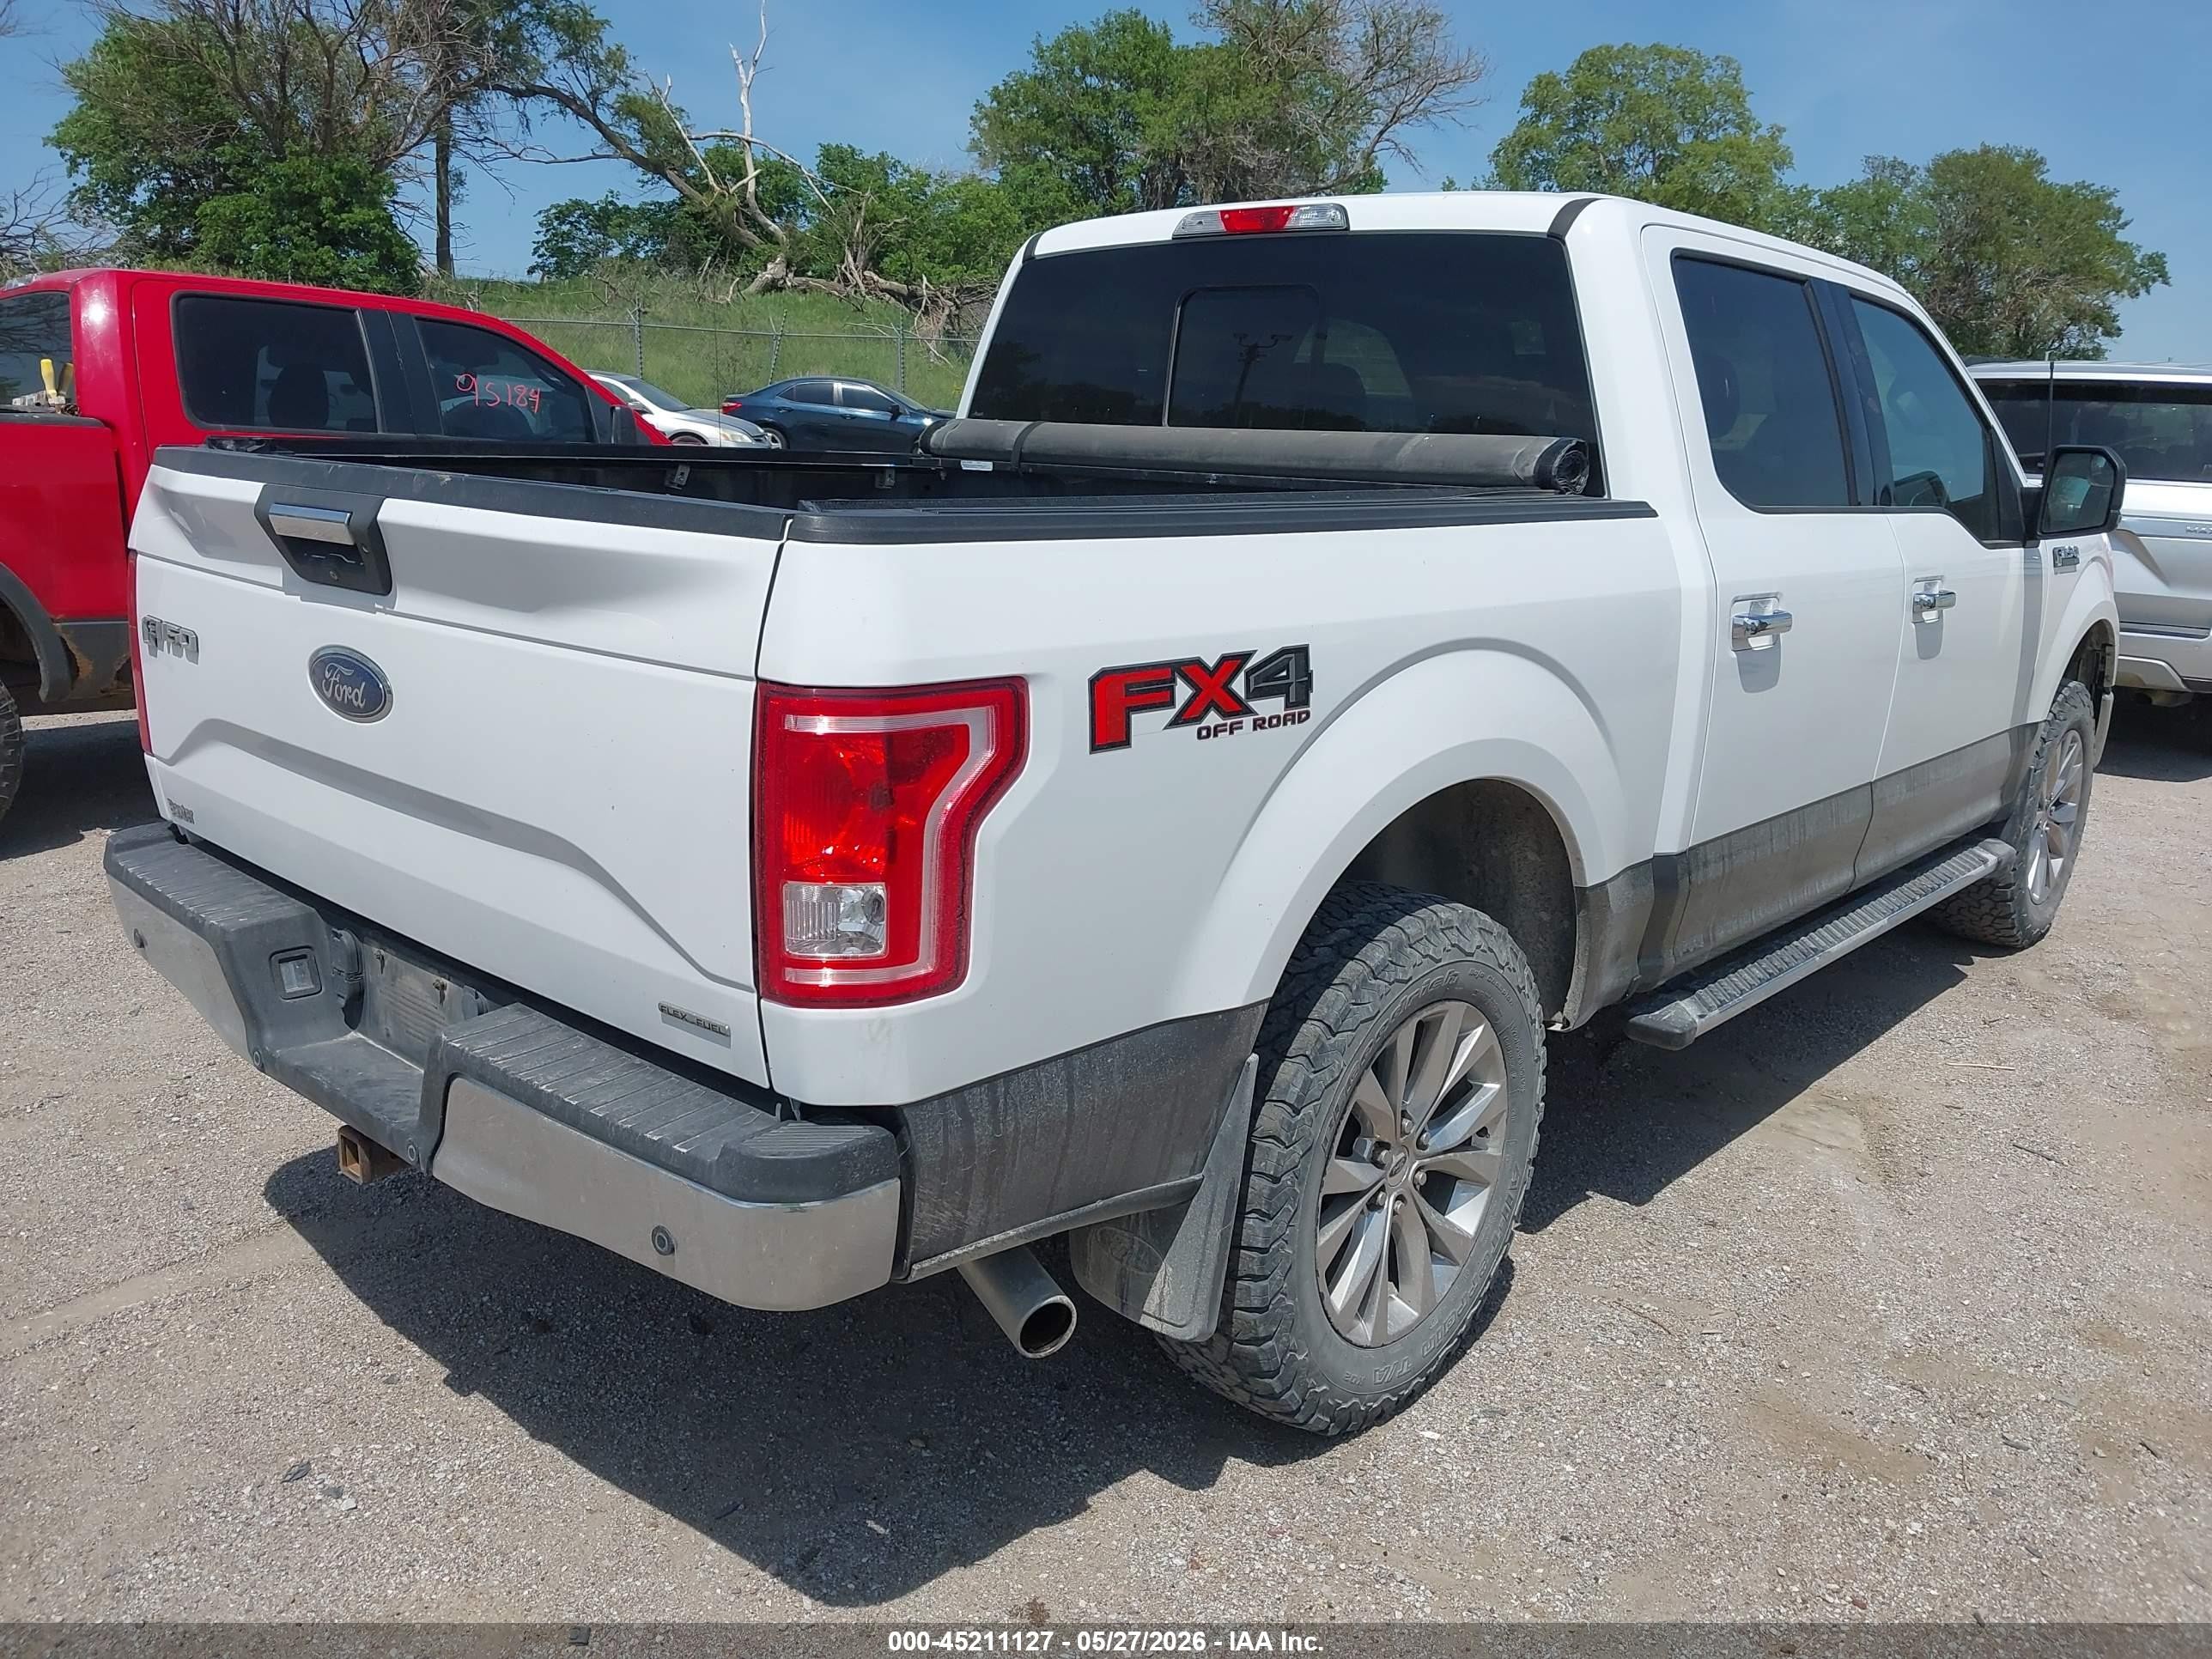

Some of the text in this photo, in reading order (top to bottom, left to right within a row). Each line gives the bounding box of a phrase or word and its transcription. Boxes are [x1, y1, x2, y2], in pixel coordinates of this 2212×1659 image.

[456, 373, 541, 414] 95184
[322, 662, 366, 709] Ford
[1088, 643, 1313, 755] FX4
[1196, 710, 1311, 741] OFF ROAD
[659, 1004, 727, 1036] FLEX FUEL
[1374, 1356, 1413, 1385] T/A
